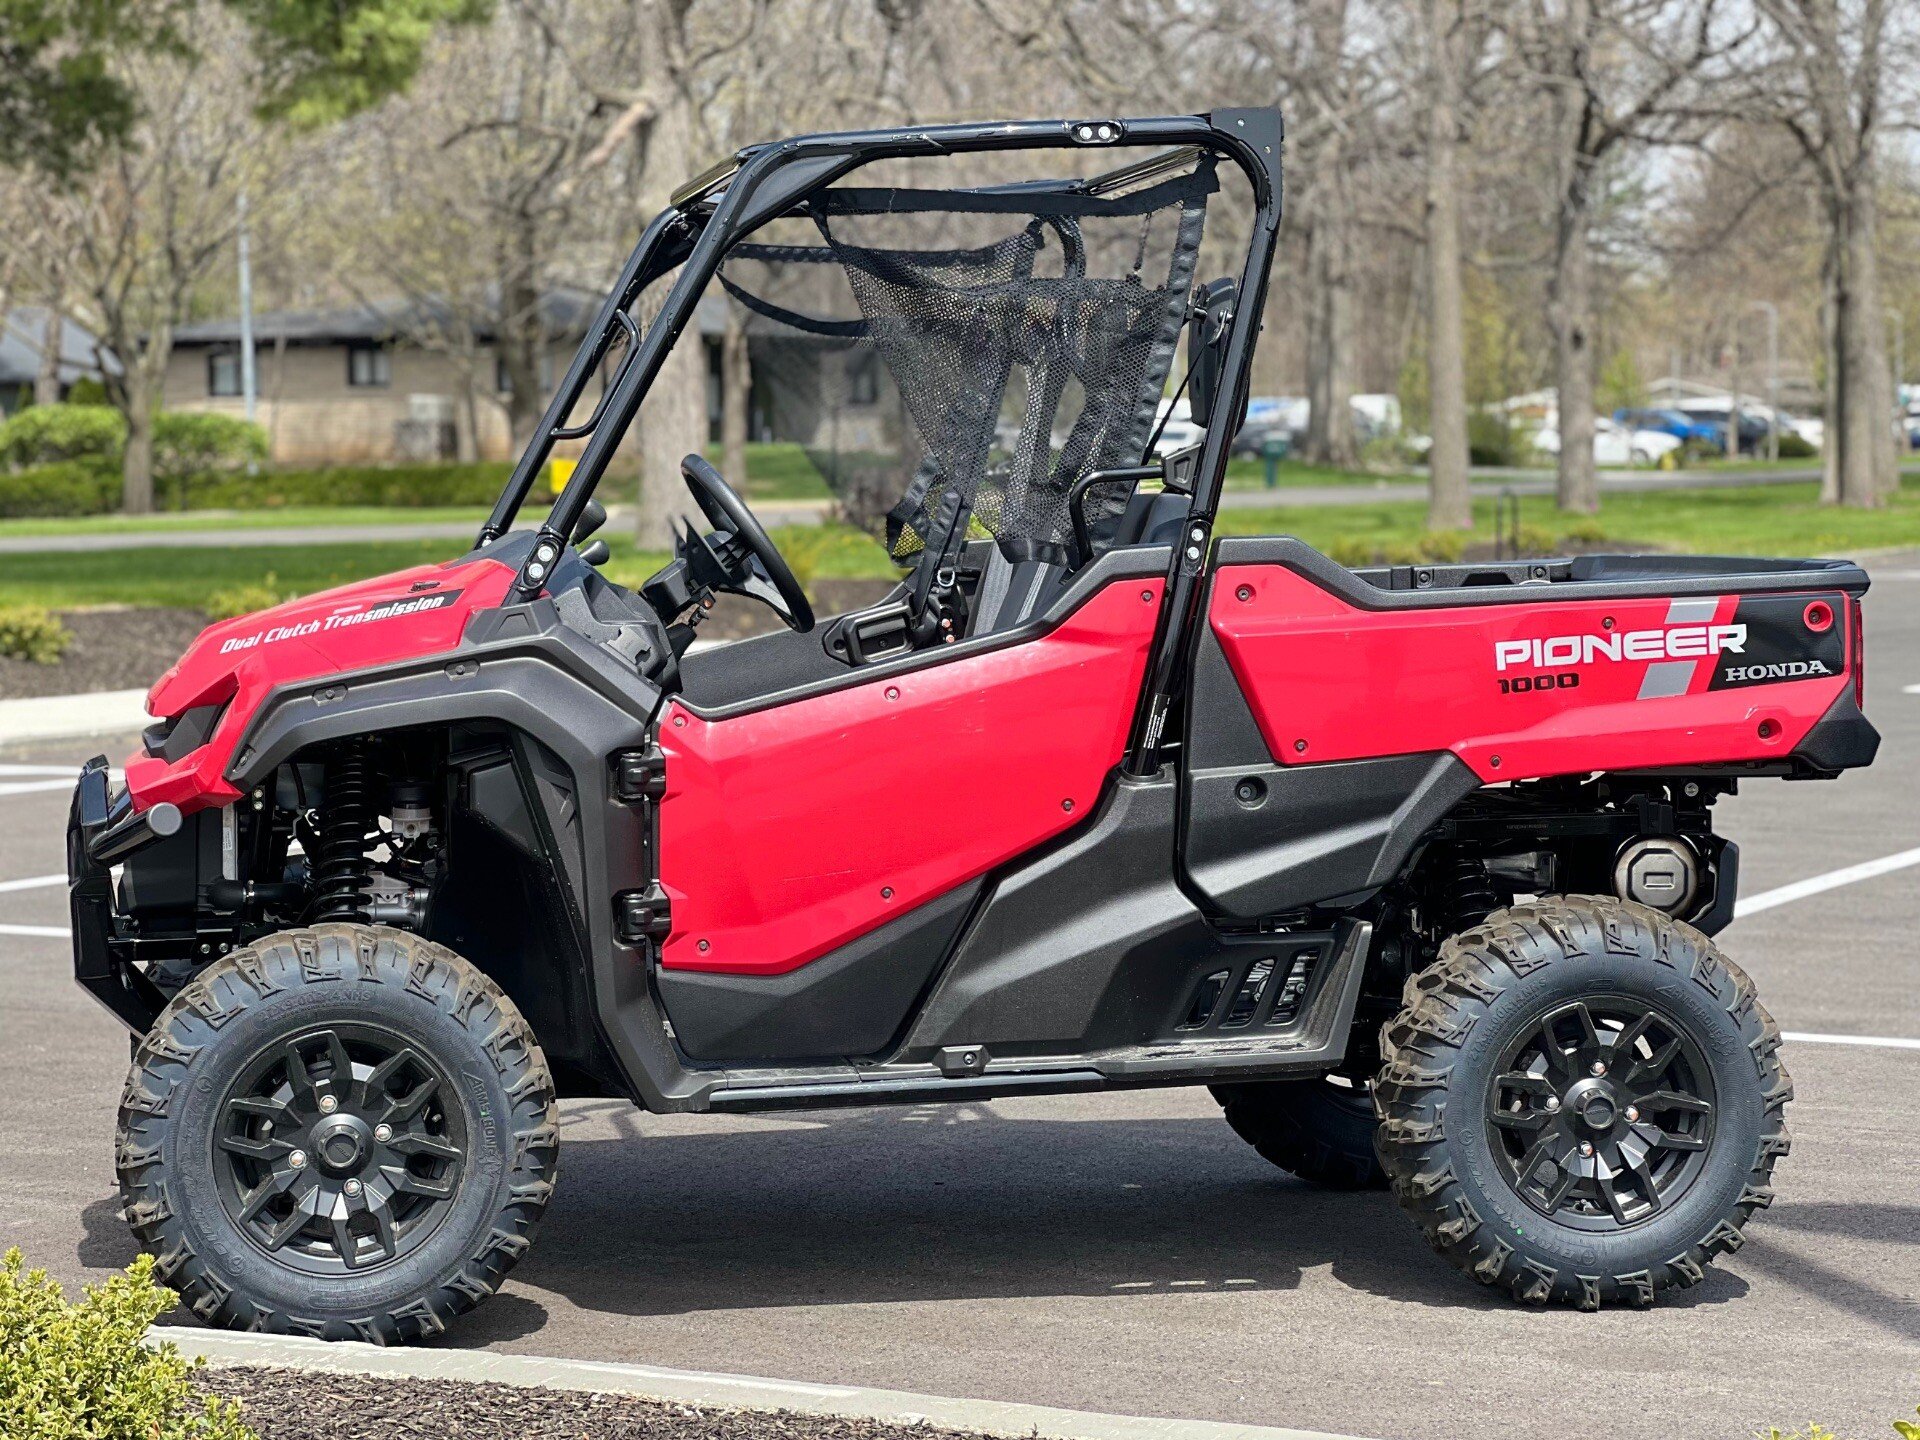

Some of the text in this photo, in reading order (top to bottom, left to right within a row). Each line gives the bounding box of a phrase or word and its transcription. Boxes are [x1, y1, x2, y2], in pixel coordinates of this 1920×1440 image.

[220, 595, 445, 654] Dual Clutch Transmission
[1495, 624, 1747, 671] PIONEER
[1497, 672, 1580, 694] 1000
[1725, 660, 1832, 682] HONDA
